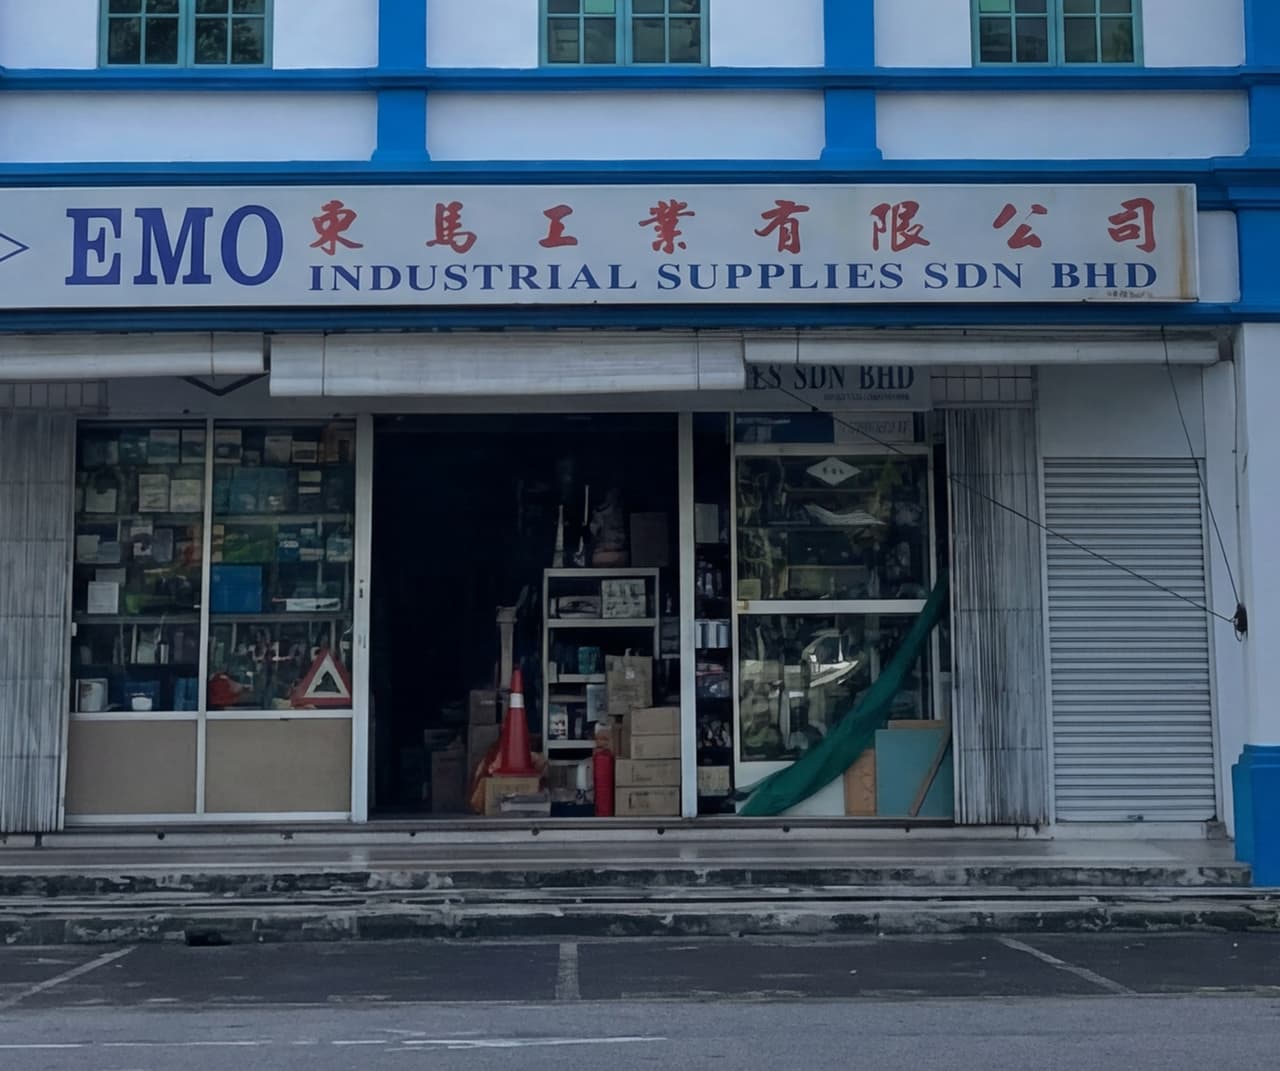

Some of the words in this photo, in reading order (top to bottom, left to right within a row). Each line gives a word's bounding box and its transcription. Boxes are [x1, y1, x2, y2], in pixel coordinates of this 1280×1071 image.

[64, 204, 284, 287] EMO
[309, 197, 1158, 255] 東馬工業有限公司
[308, 263, 638, 292] INDUSTRIAL
[657, 262, 904, 291] SUPPLIES
[924, 262, 1023, 290] SDN
[1050, 262, 1158, 289] BHD
[793, 364, 846, 391] SDN
[858, 364, 915, 390] BHD
